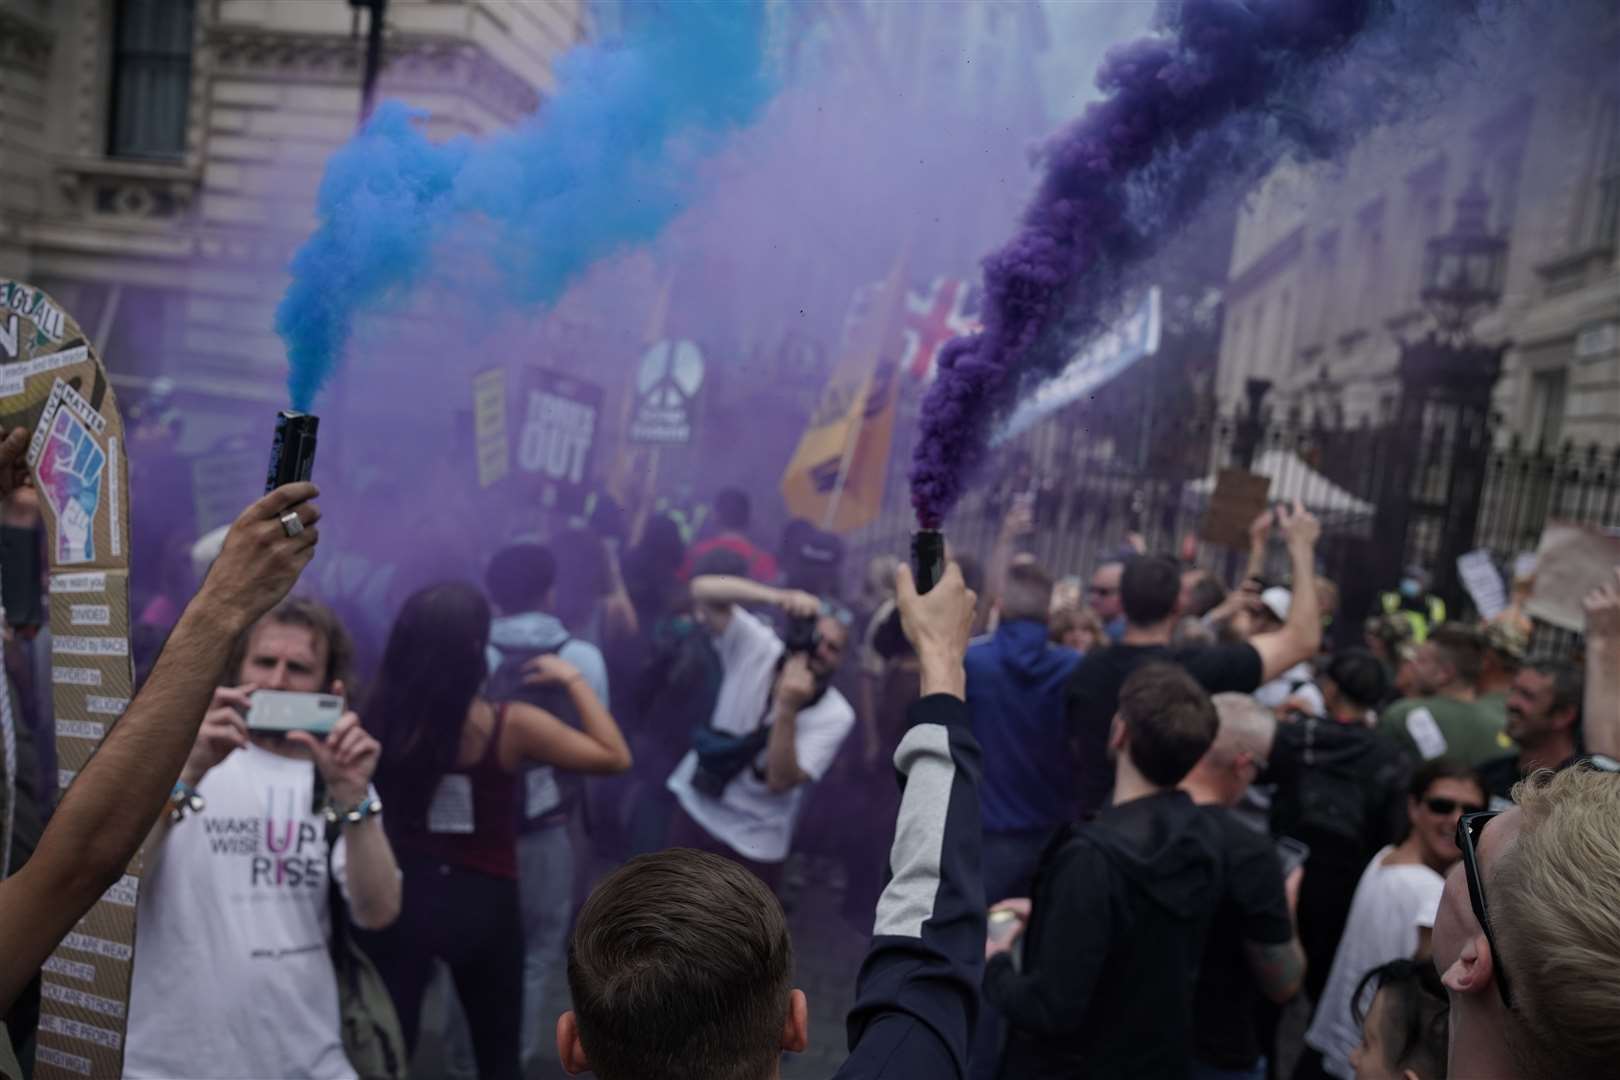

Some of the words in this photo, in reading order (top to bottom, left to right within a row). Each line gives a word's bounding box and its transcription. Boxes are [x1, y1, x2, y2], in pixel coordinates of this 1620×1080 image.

[10, 287, 32, 315] GO
[33, 302, 62, 339] ALL
[64, 388, 105, 430] MATTER
[518, 425, 591, 485] OUT
[90, 576, 105, 590] you
[72, 607, 108, 622] DIVIDED
[54, 637, 88, 651] DIVIDED
[89, 639, 99, 653] by
[100, 639, 127, 653] RACE
[54, 668, 89, 682] DIVIDED
[90, 670, 101, 685] by
[56, 721, 91, 735] DIVIDED
[203, 817, 260, 834] WAKE
[266, 797, 317, 855] UP
[210, 837, 260, 855] WISE
[251, 857, 321, 889] RISE
[64, 934, 80, 948] OU
[81, 937, 99, 952] ARE
[102, 943, 130, 959] WEAK
[47, 958, 95, 978] OGETHER
[63, 989, 81, 1003] ARE
[40, 1016, 56, 1030] WE
[59, 1019, 78, 1036] THE
[79, 1025, 119, 1048] PEOPLE
